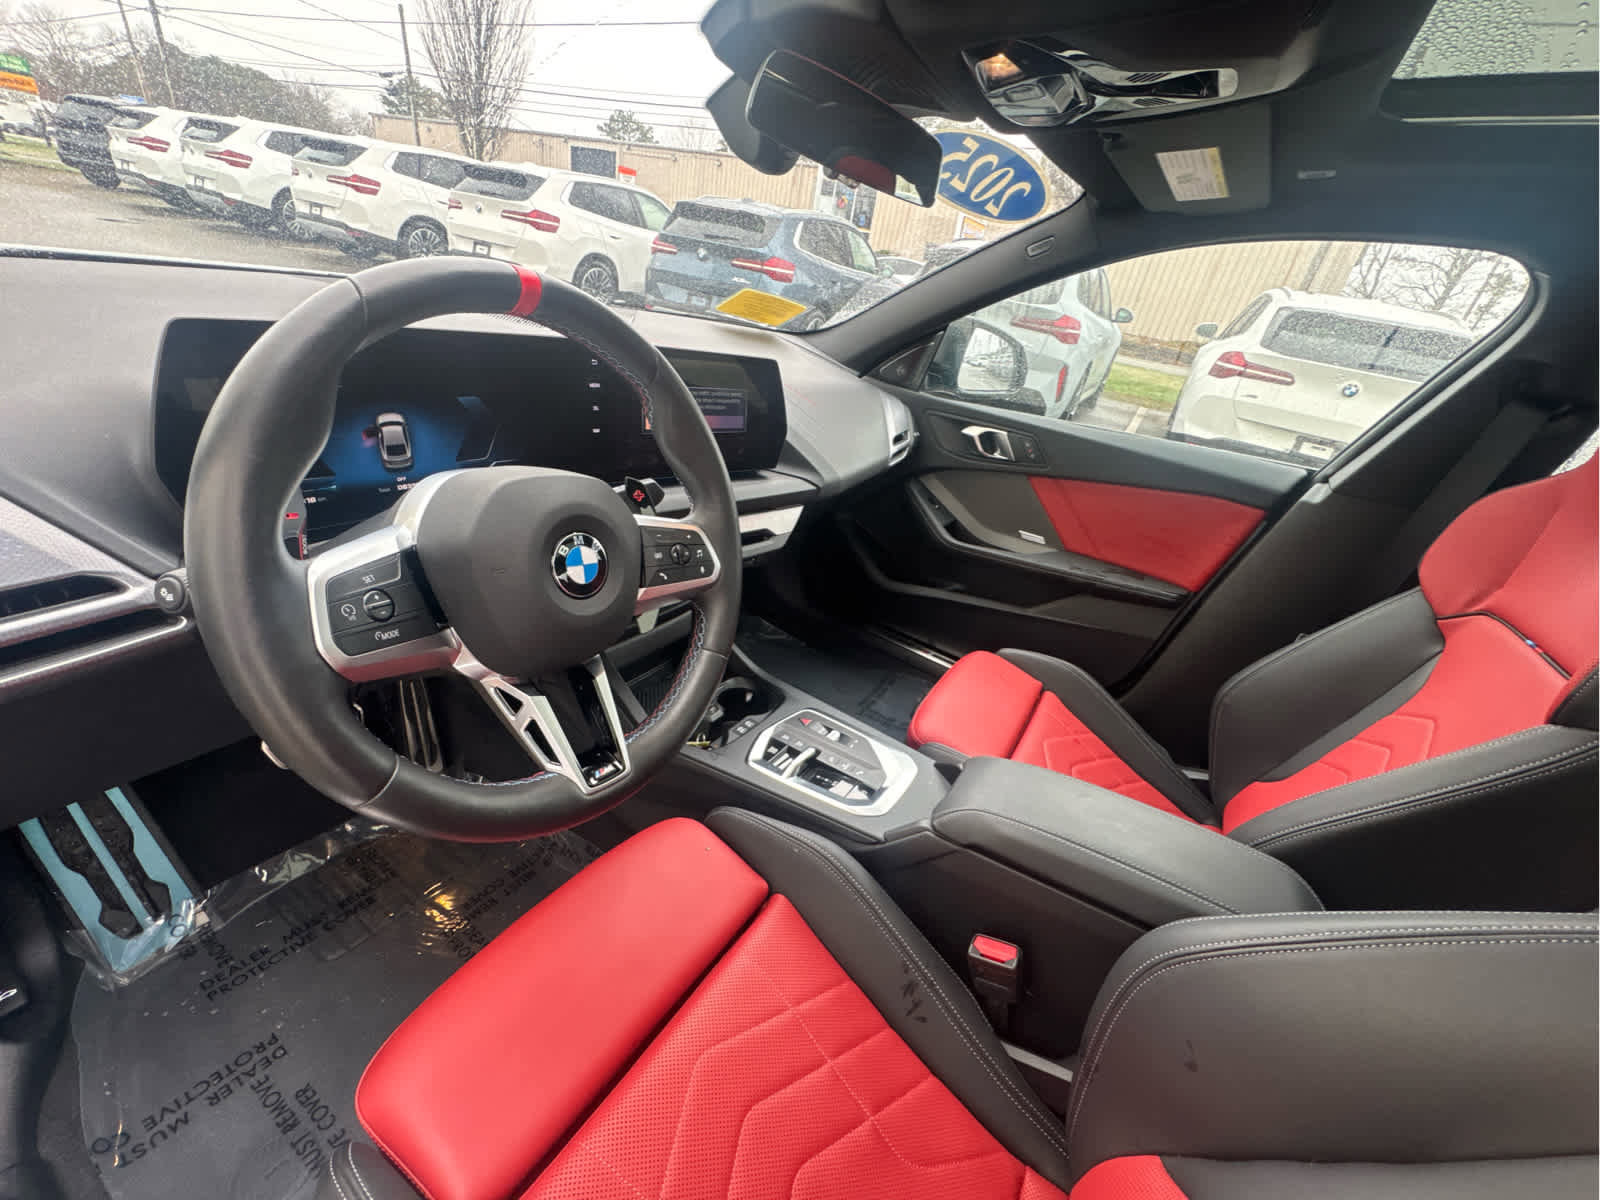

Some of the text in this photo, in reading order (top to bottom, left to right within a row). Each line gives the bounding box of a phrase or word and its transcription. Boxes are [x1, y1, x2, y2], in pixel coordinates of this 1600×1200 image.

[558, 535, 602, 556] BMW
[362, 574, 376, 583] SET
[381, 629, 400, 641] MODE
[200, 946, 272, 992] DEALER
[206, 931, 317, 1002] PROTECTIVE
[141, 1032, 280, 1131] PROTECTIVE
[117, 1045, 288, 1169] DEALER MUST
[295, 1082, 337, 1130] COVER
